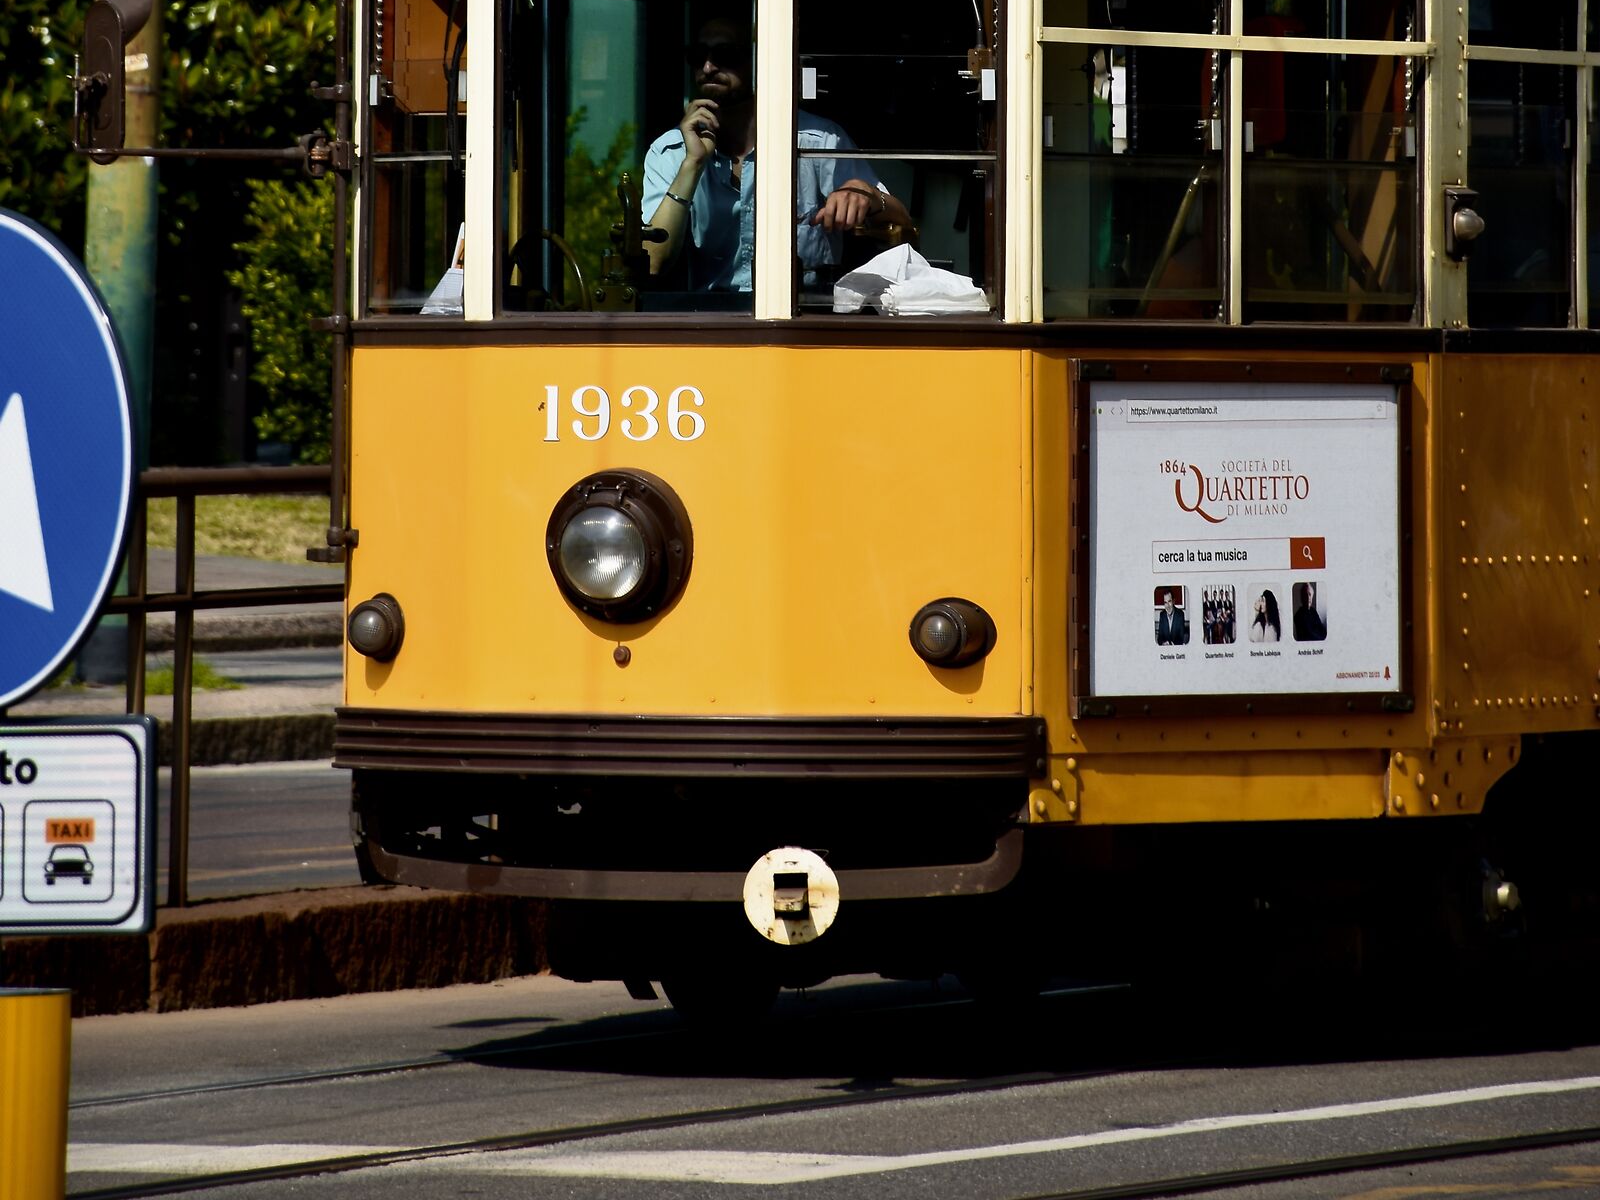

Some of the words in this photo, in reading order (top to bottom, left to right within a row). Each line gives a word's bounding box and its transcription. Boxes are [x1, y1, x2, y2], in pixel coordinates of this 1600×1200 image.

[543, 385, 706, 442] 1936
[1130, 406, 1218, 418] https://www.quartettomilano.it
[1160, 459, 1187, 476] 1864
[1221, 458, 1268, 473] SOCIETÀ
[1272, 459, 1292, 472] DEL
[1175, 464, 1310, 524] QUARTETTO
[1227, 504, 1239, 516] DI
[1244, 503, 1288, 515] MILANO
[1158, 551, 1184, 563] cerca
[1186, 549, 1195, 562] la
[1197, 549, 1212, 562] tua
[1214, 548, 1248, 561] musica
[50, 823, 91, 838] TAXI
